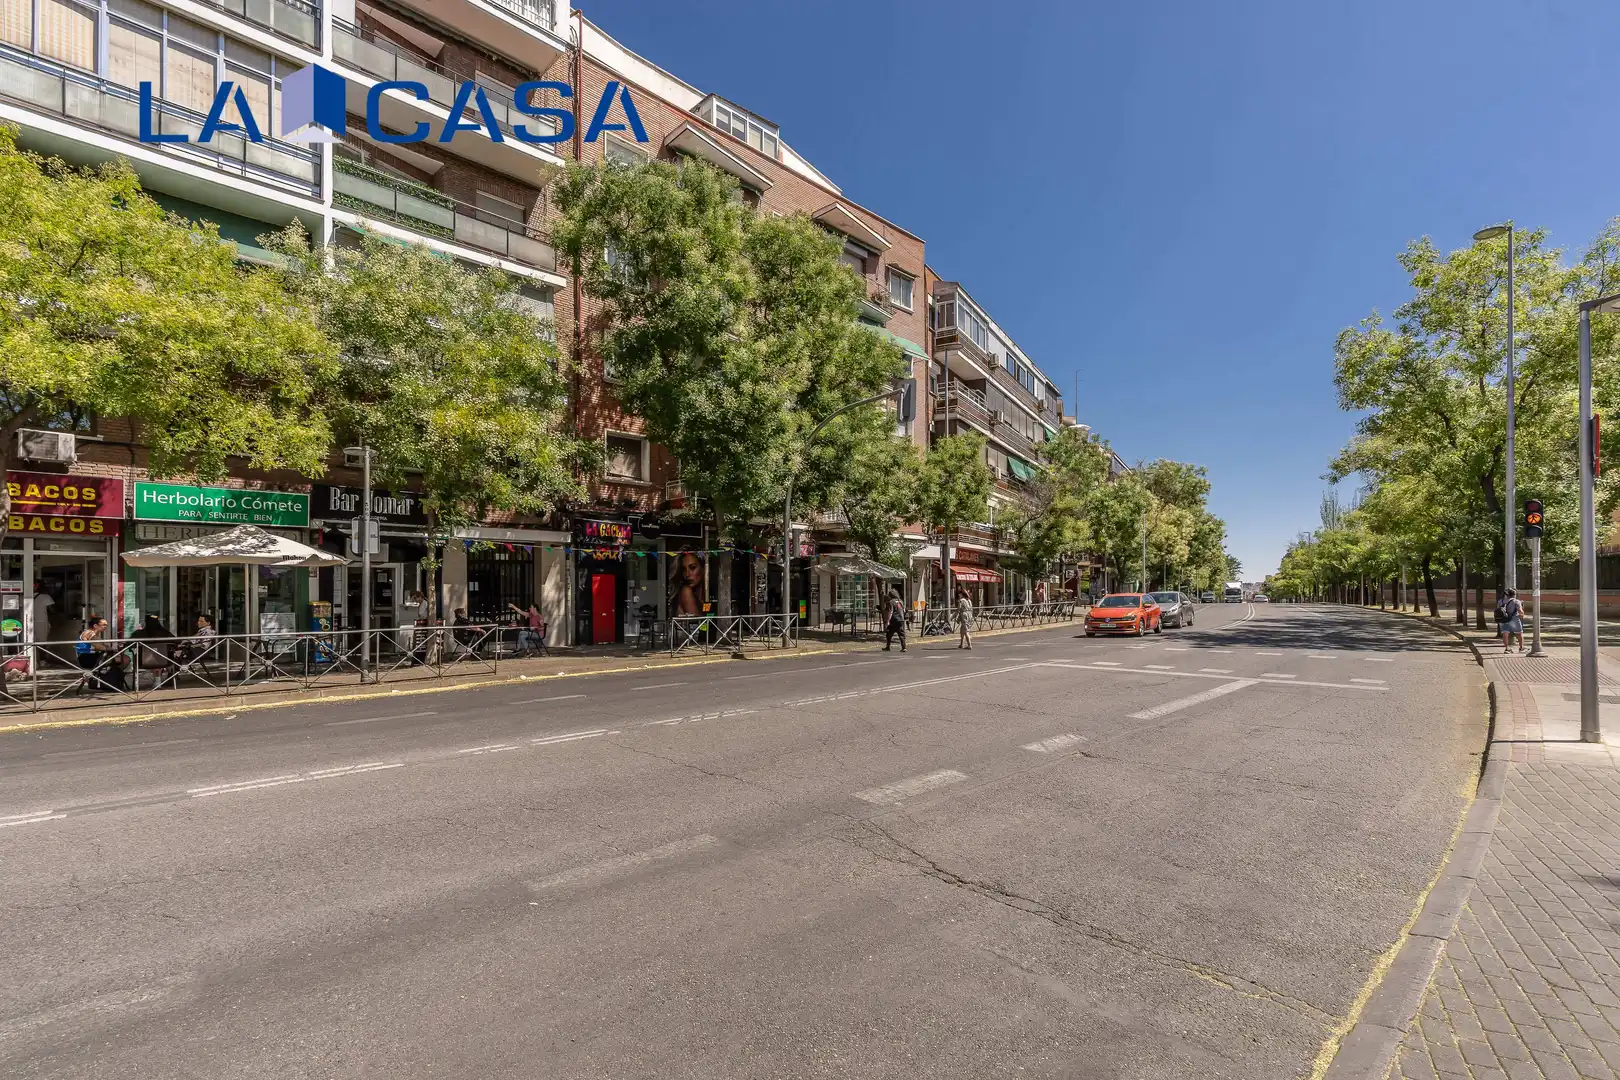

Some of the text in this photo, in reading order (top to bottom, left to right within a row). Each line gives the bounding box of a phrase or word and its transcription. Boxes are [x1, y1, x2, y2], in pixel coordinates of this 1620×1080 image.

[143, 490, 302, 513] Herbolario Cómete
[330, 487, 359, 511] Bar
[8, 516, 104, 533] BACOS
[178, 510, 202, 518] PARA
[208, 511, 248, 521] SENTIRTE
